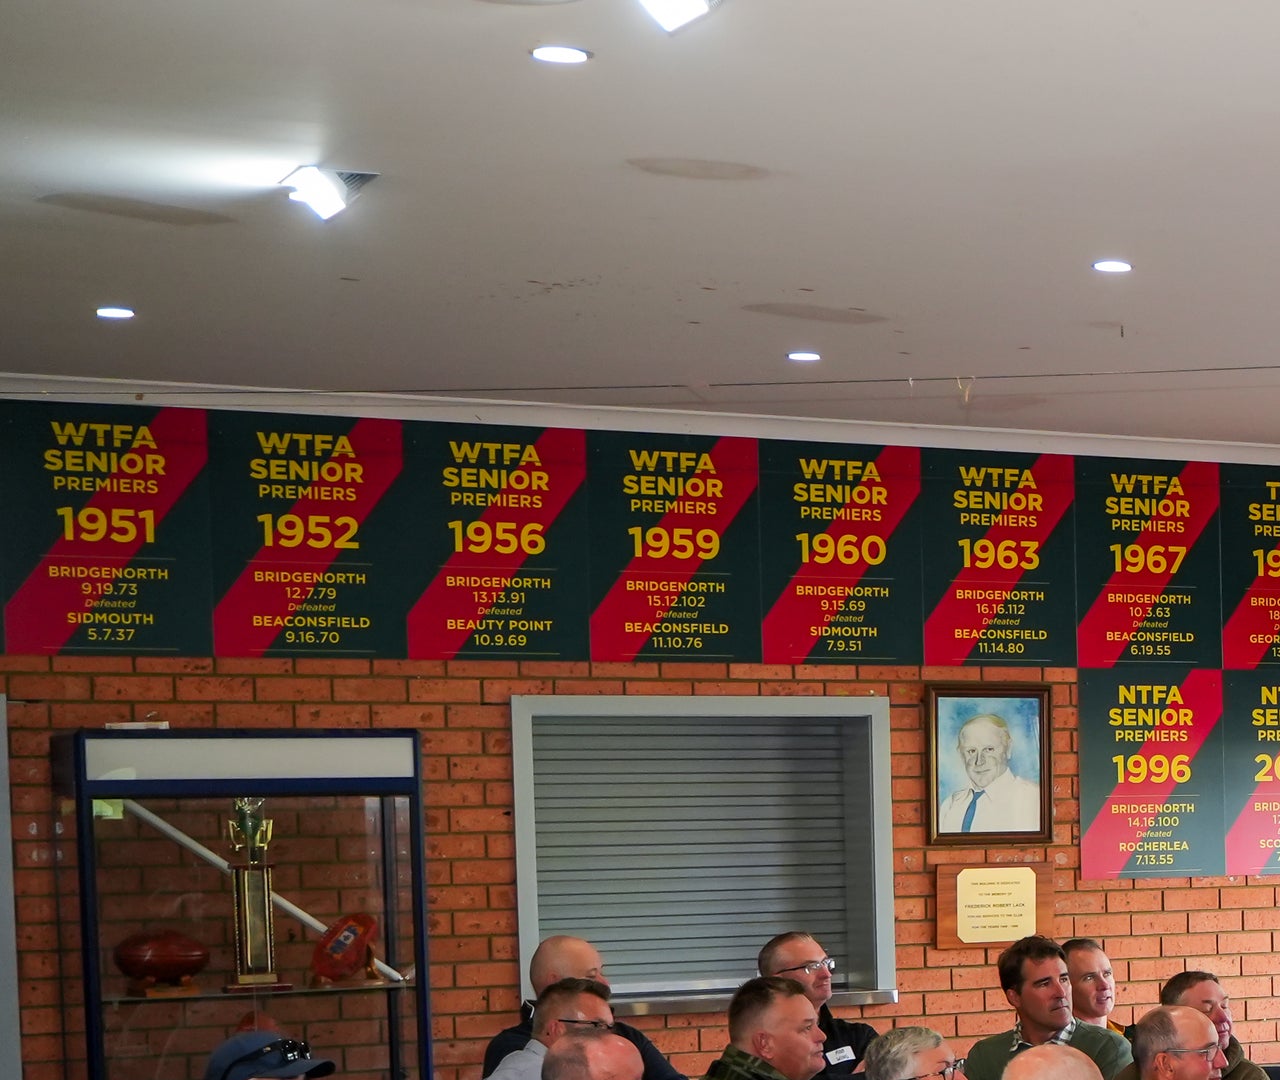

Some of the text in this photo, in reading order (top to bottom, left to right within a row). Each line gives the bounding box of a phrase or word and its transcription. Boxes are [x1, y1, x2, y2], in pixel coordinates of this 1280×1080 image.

[50, 421, 158, 449] WTFA
[256, 431, 356, 458] WTFA
[44, 448, 165, 475] SENIOR
[449, 440, 542, 467] WTFA
[629, 449, 717, 475] WTFA
[799, 458, 881, 483] WTFA
[959, 465, 1037, 489] WTFA
[53, 475, 159, 494] PREMIERS
[1110, 473, 1185, 496] WTFA
[953, 489, 1043, 511] SENIOR
[56, 506, 156, 544] 1951
[959, 512, 1038, 527] PREMIERS
[257, 513, 360, 550] 1952
[447, 519, 546, 555] 1956
[627, 526, 721, 560] 1959
[795, 532, 887, 566] 1960
[957, 538, 1040, 571] 1963
[1109, 543, 1187, 574] 1967
[48, 565, 169, 580] BRIDGENORTH
[81, 582, 139, 596] 9.19.73
[956, 589, 1045, 601] BRIDGENORTH
[85, 598, 139, 610] Defeated
[976, 602, 1026, 616] 16.16.112
[67, 611, 155, 625] SIDMOUTH
[982, 616, 1021, 626] Defeated
[86, 626, 136, 642] 5.7.37
[954, 628, 1048, 640] BEACONSFIELD
[977, 641, 1025, 655] 11.14.80
[1118, 684, 1184, 705] NTFA
[1109, 707, 1193, 726] SENIOR
[1114, 728, 1188, 743] PREMIERS
[1112, 753, 1192, 783] 1996
[1111, 803, 1195, 814] BRIDGENORTH
[1127, 814, 1181, 828] 14.16.100
[1135, 829, 1174, 839] Defeated
[1119, 840, 1189, 852] ROCHERLEA
[1135, 852, 1175, 866] 7.13.55
